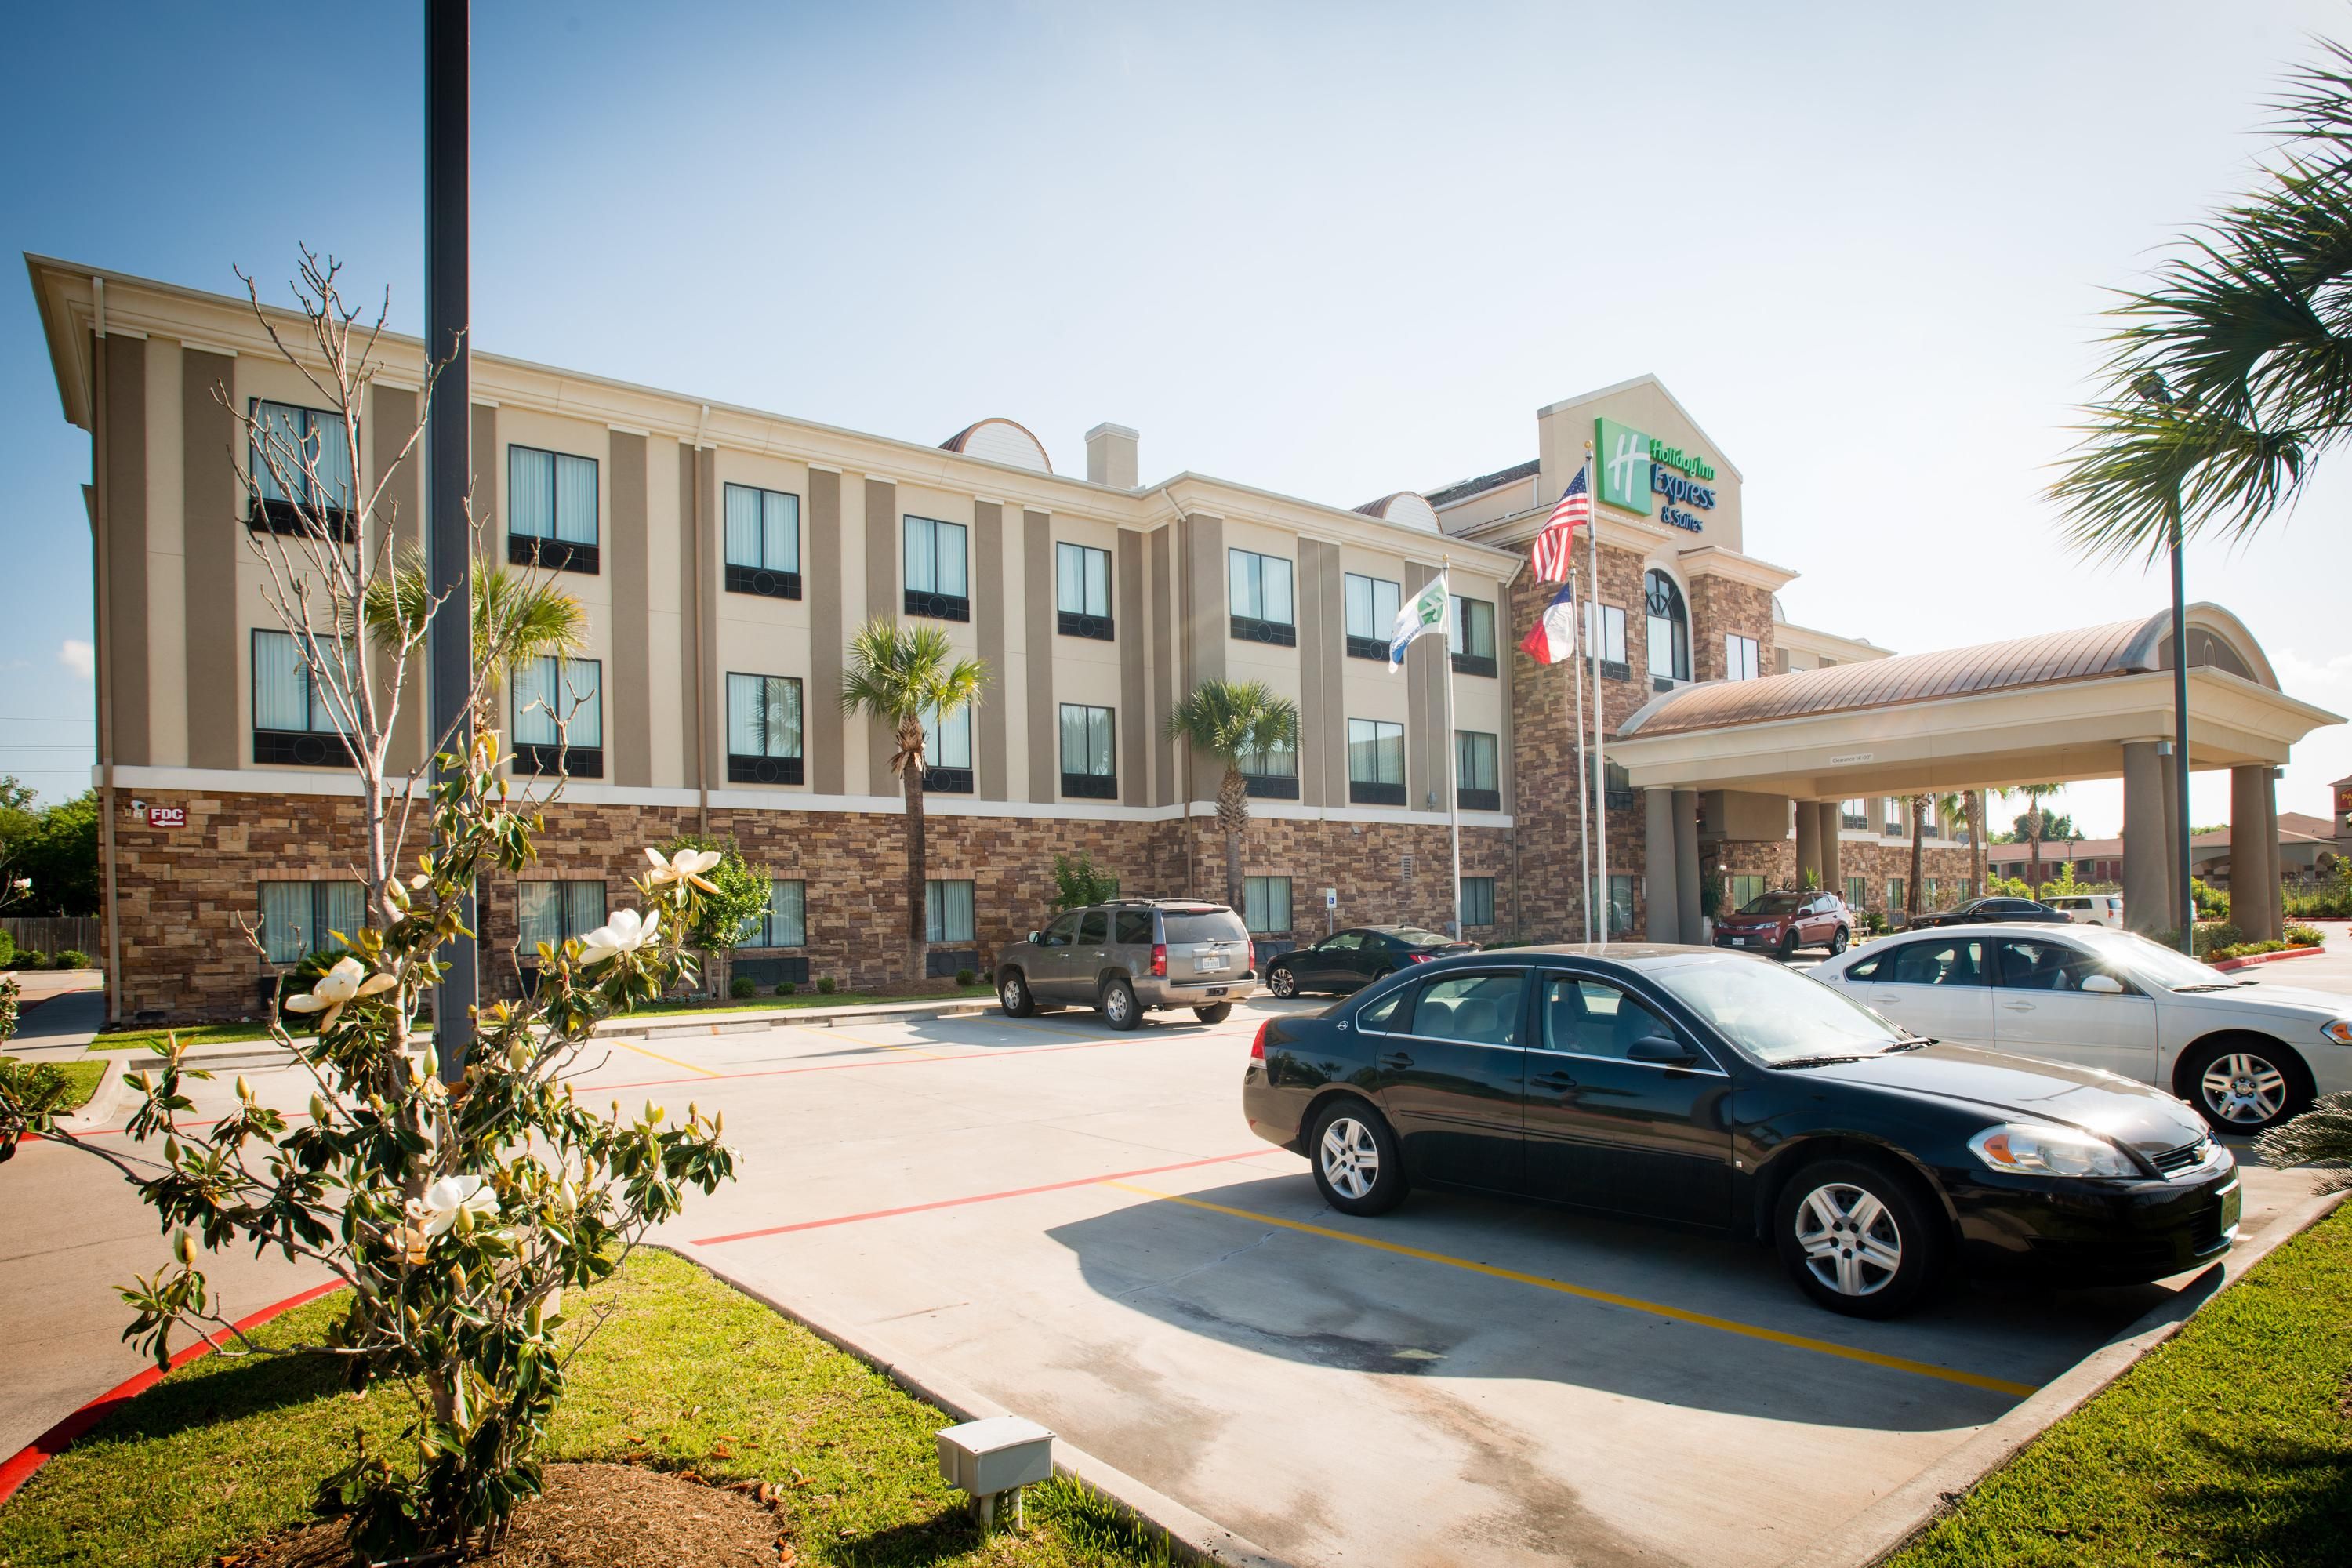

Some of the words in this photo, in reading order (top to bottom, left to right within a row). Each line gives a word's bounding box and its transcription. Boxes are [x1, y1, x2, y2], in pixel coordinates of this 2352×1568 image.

[1650, 438, 1697, 477] Holiday
[1697, 455, 1715, 481] Inn
[1650, 463, 1716, 510] Express
[1661, 506, 1671, 524] &
[1670, 510, 1703, 533] Suites
[151, 808, 183, 820] FDC
